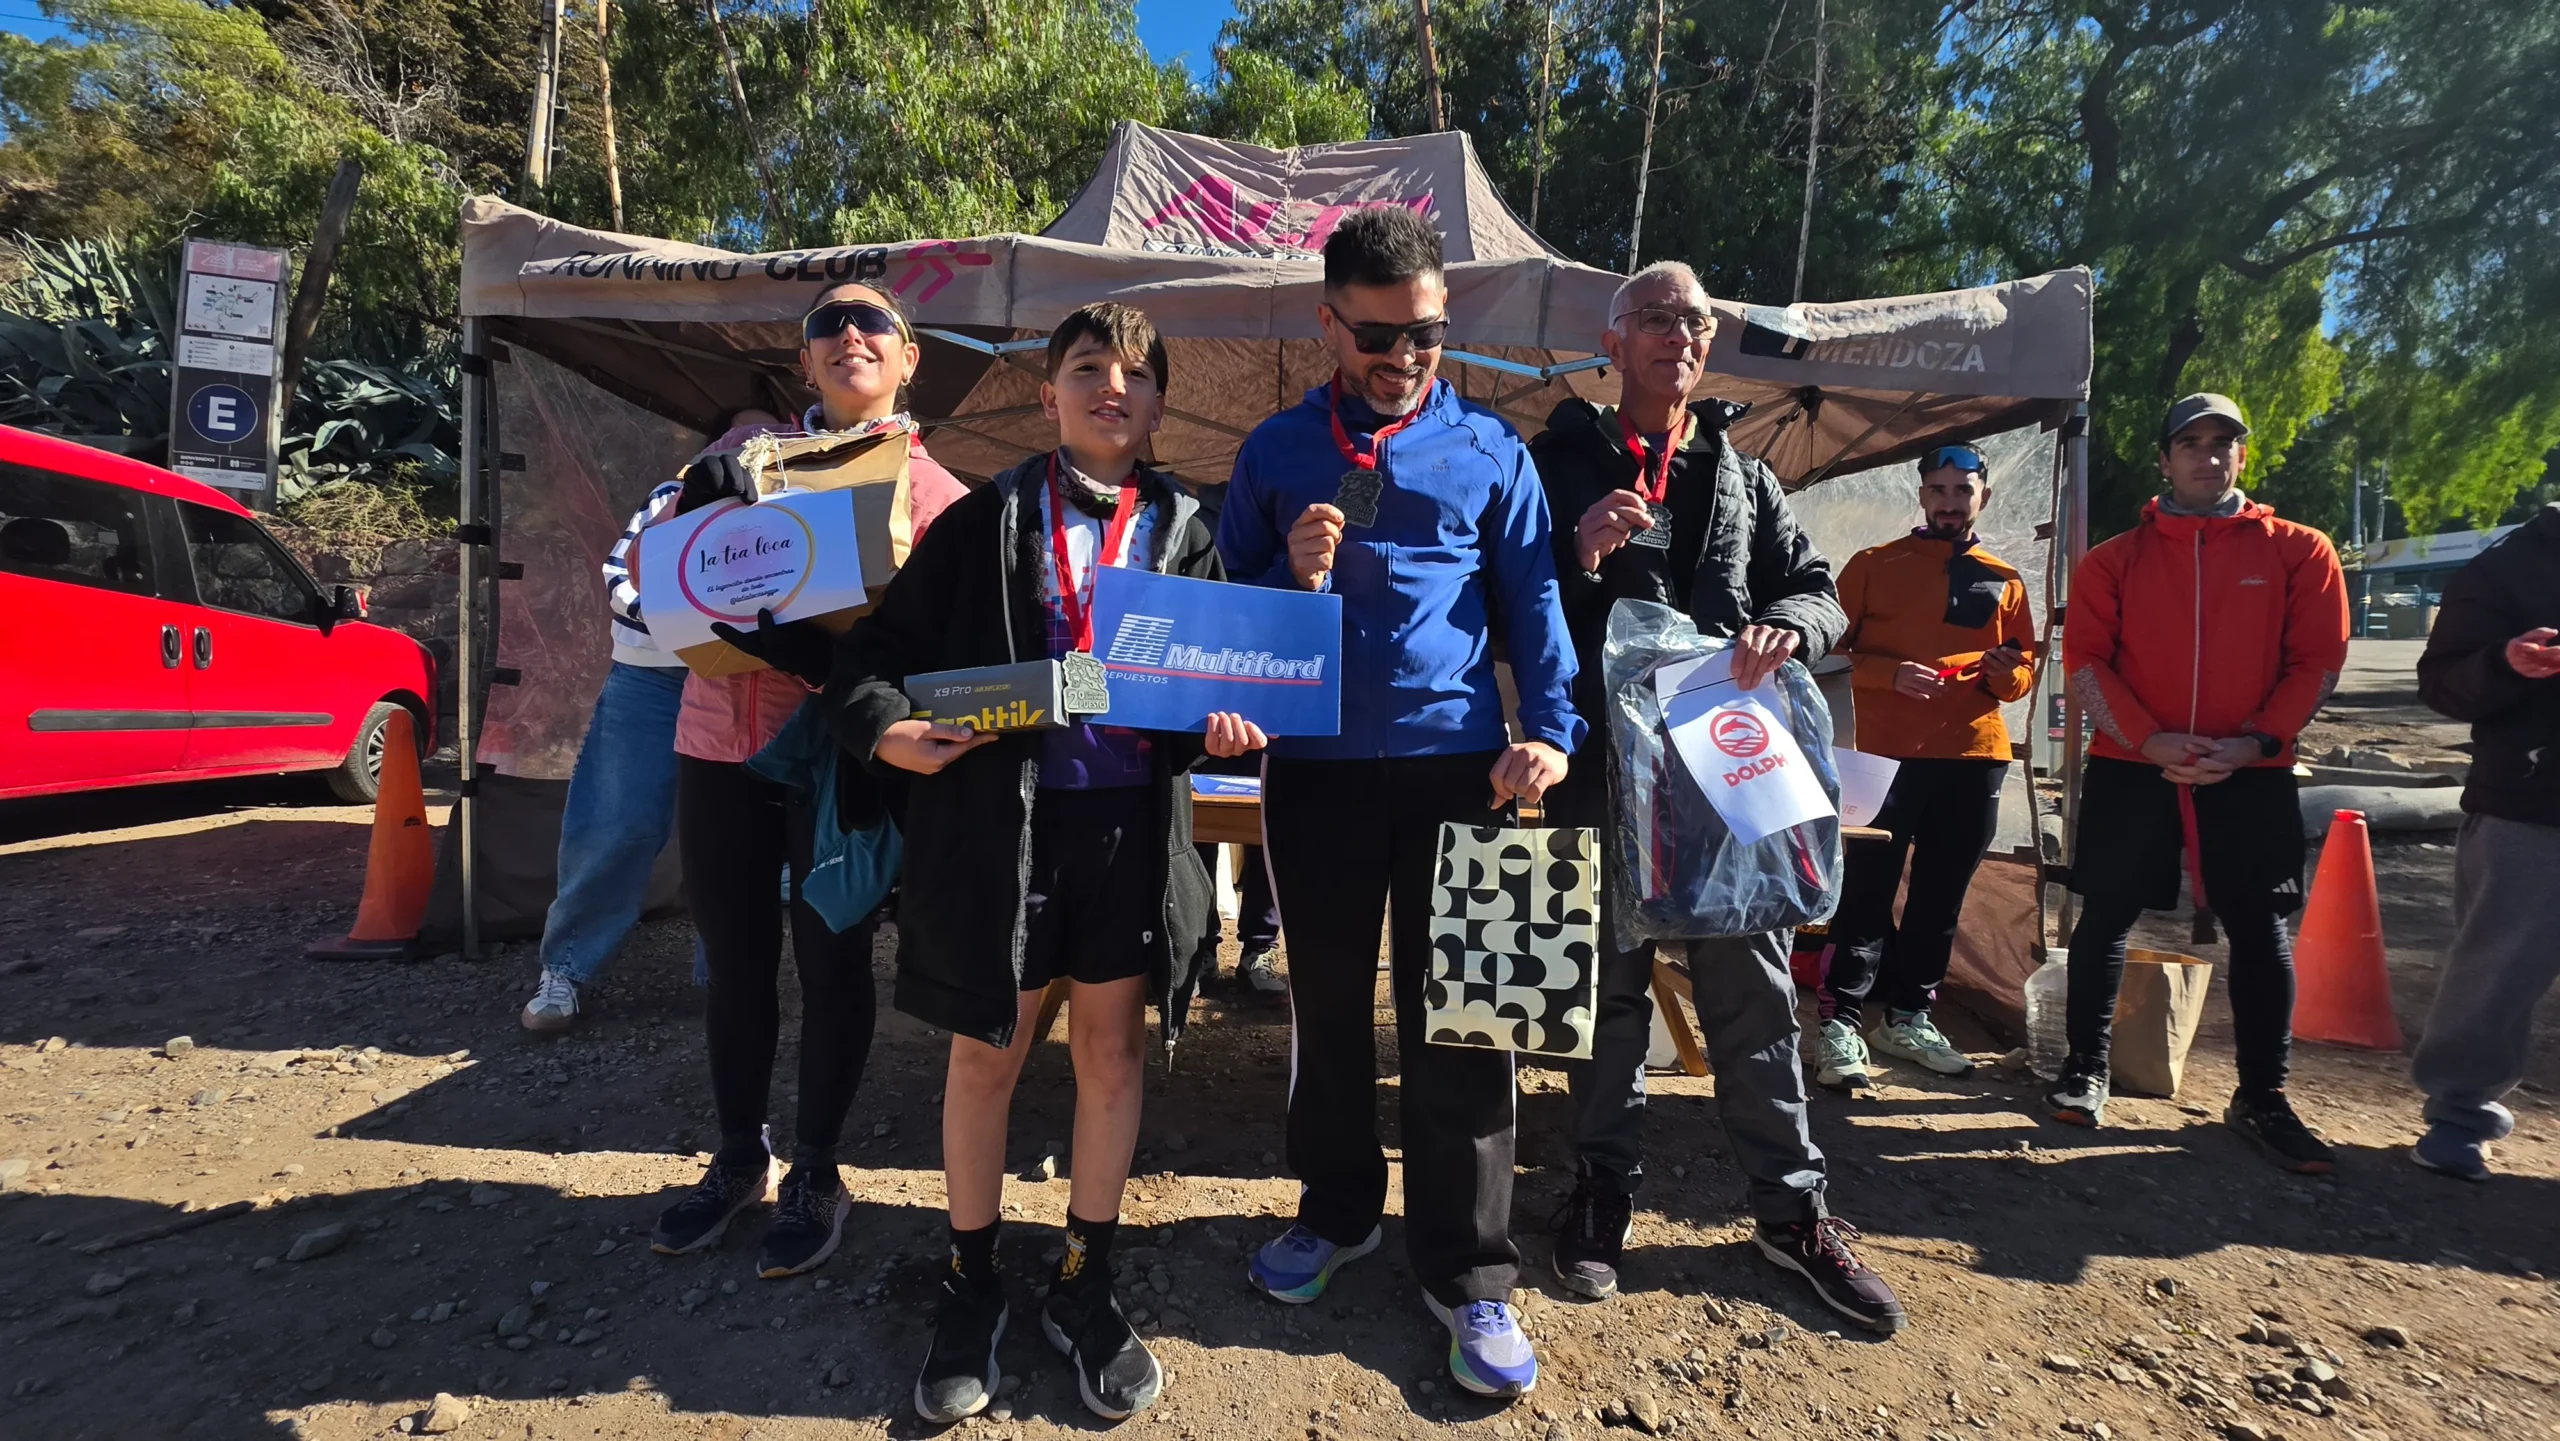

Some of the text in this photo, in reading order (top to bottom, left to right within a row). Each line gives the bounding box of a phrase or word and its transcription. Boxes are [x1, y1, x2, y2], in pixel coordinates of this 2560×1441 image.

[764, 246, 889, 282] CLUB
[1806, 336, 1986, 373] MENDOZA
[208, 396, 236, 431] E
[700, 549, 720, 574] La
[756, 536, 793, 556] loca
[1103, 671, 1169, 684] REPUESTOS
[1163, 642, 1325, 680] Multiford
[934, 687, 950, 698] X9
[951, 685, 972, 696] Pro
[1080, 701, 1106, 709] PUESTO
